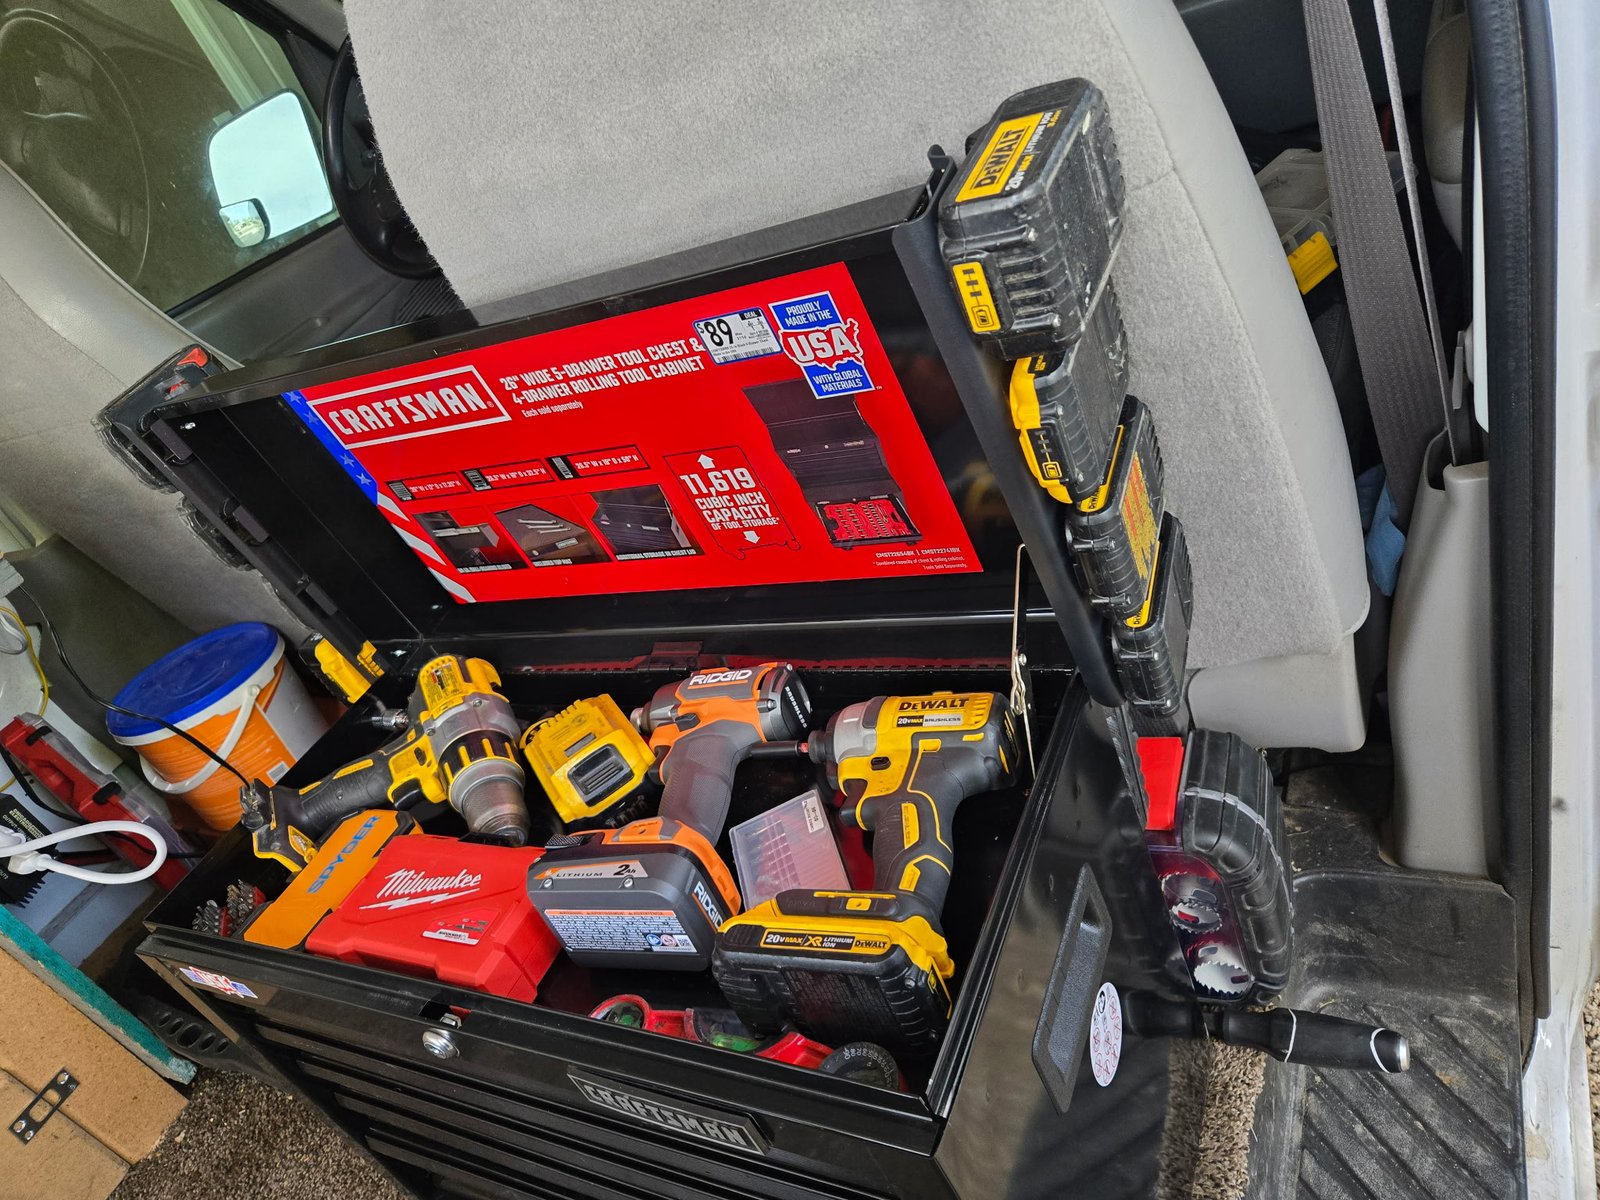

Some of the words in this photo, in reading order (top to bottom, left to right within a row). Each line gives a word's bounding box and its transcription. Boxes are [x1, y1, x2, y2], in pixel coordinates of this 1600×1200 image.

[785, 314, 804, 327] MADE
[804, 312, 815, 322] IN
[814, 310, 833, 321] THE
[786, 300, 821, 316] PROUDLY
[787, 328, 858, 362] USA
[520, 369, 553, 388] WIDE
[550, 356, 617, 381] 5-DRAWER
[614, 349, 649, 366] TOOL
[646, 339, 689, 361] CHEST
[689, 338, 706, 352] &
[511, 384, 573, 405] 4-DRAWER
[570, 373, 620, 394] ROLLING
[617, 366, 652, 384] TOOL
[649, 356, 705, 379] CABINET
[813, 372, 834, 385] WITH
[833, 369, 864, 382] GLOBAL
[821, 378, 863, 392] MATERIALS
[328, 382, 488, 435] CRAFTSMAN
[522, 409, 539, 418] Each
[538, 406, 552, 415] sold
[550, 400, 584, 414] separately
[680, 468, 756, 497] 11,619
[695, 495, 734, 510] CUBIC
[733, 492, 766, 506] INCH
[702, 504, 773, 523] CAPACITY
[711, 522, 722, 530] OF
[722, 521, 743, 530] TOOL
[689, 670, 752, 686] RIDGID
[784, 686, 808, 728] BRUSHLESS
[308, 816, 381, 894] SPYDER
[376, 868, 482, 899] Milwaukee
[694, 880, 724, 929] RIDGID
[824, 936, 853, 944] LITHIUM
[583, 1084, 747, 1146] CRAFTSMAN
